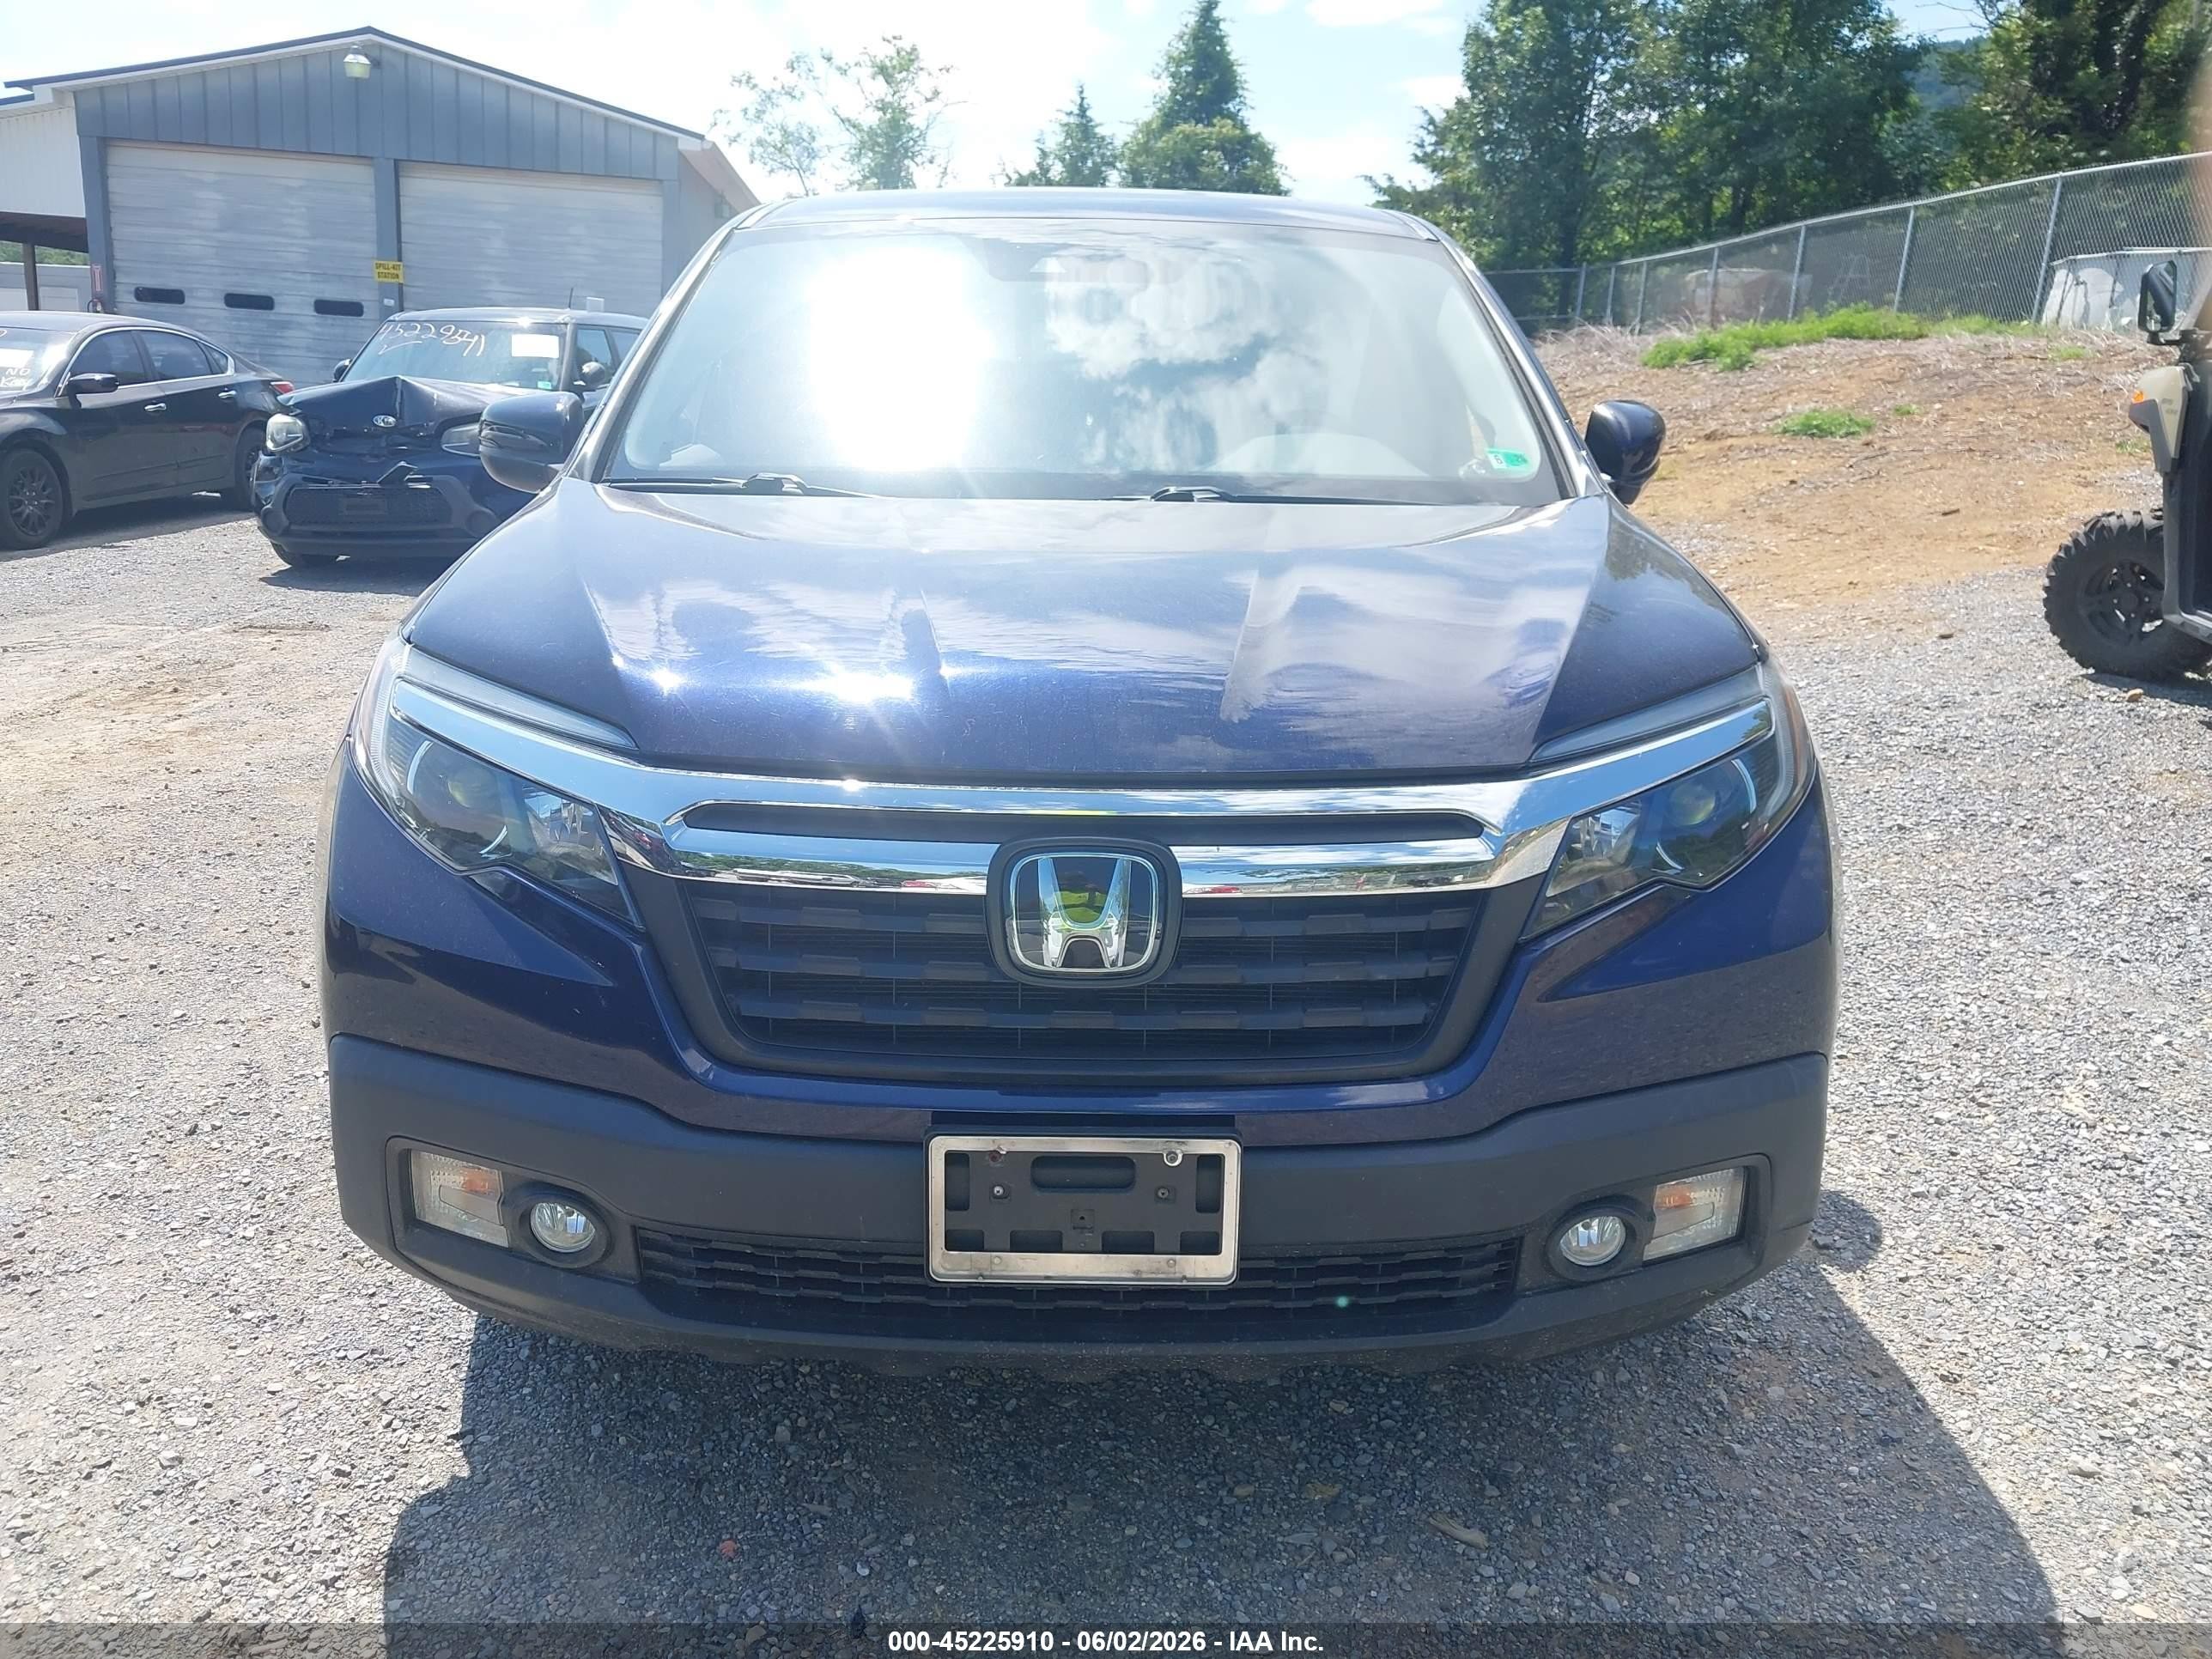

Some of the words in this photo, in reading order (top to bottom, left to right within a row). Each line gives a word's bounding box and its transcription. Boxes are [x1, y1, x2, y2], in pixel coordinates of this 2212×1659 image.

[374, 262, 401, 271] SPILL-KIT
[377, 271, 399, 280] STATION
[5, 368, 31, 376] NO
